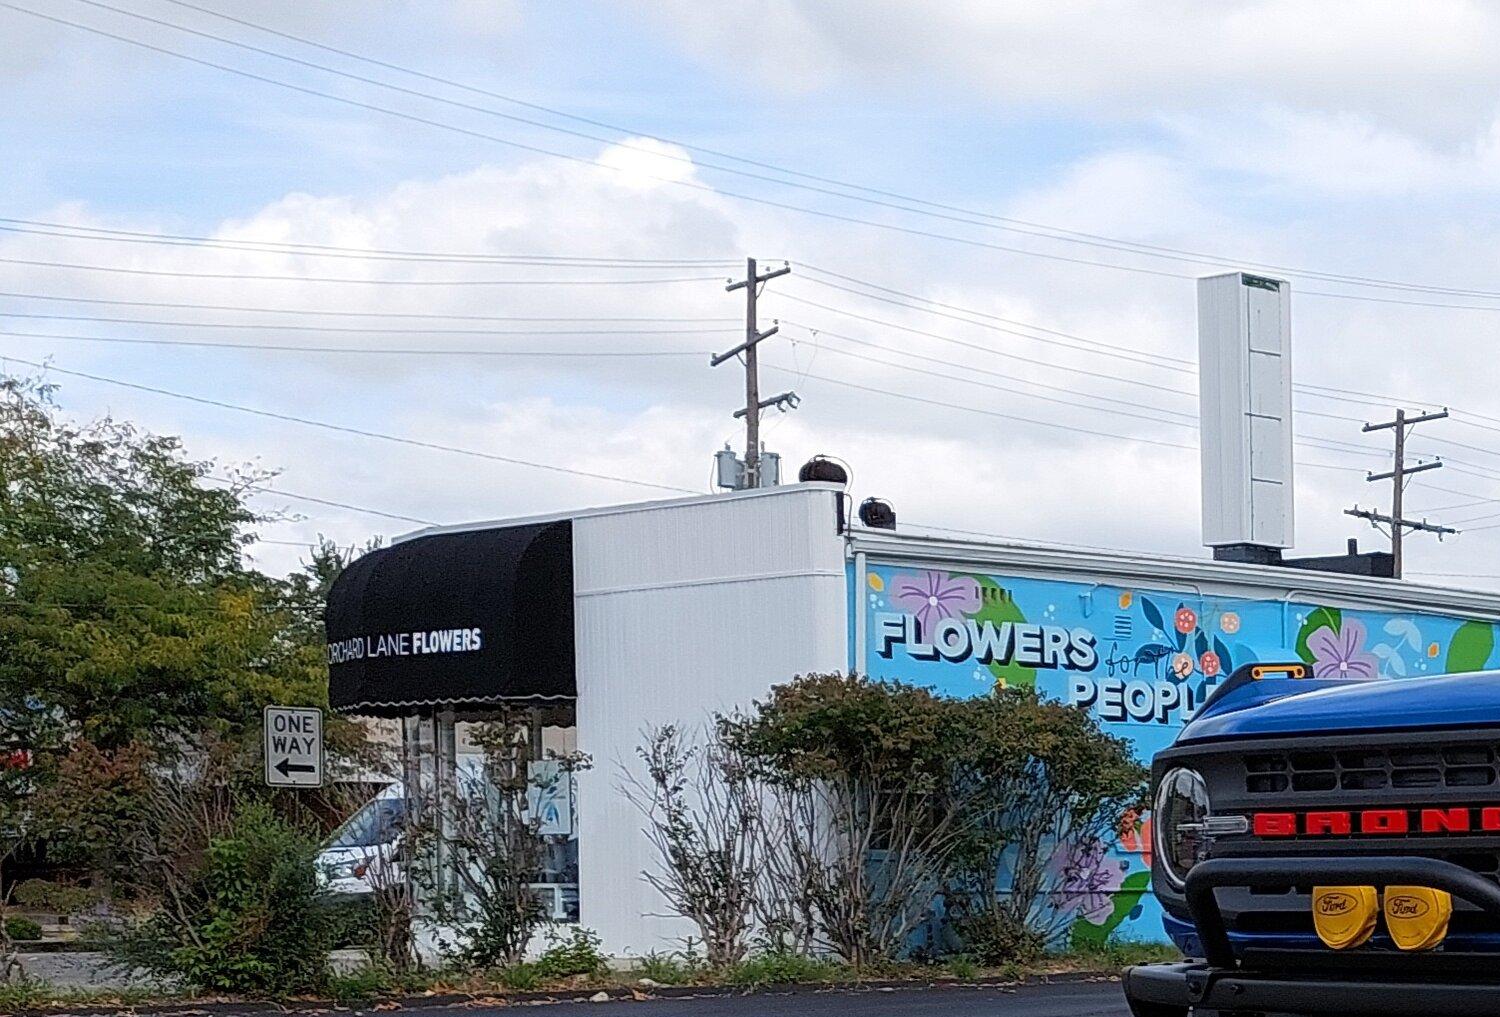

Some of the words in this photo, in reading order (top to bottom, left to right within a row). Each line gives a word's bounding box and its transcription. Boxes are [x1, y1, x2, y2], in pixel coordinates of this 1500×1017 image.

[327, 636, 364, 665] ORCHARD
[367, 633, 410, 658] LANE
[412, 627, 482, 655] FLOWERS
[874, 612, 1099, 672] FLOWERS
[1068, 674, 1218, 723] PEOPL
[273, 714, 314, 734] ONE
[272, 735, 316, 755] WAY
[1321, 896, 1347, 912] Ford
[1391, 899, 1418, 915] Ford
